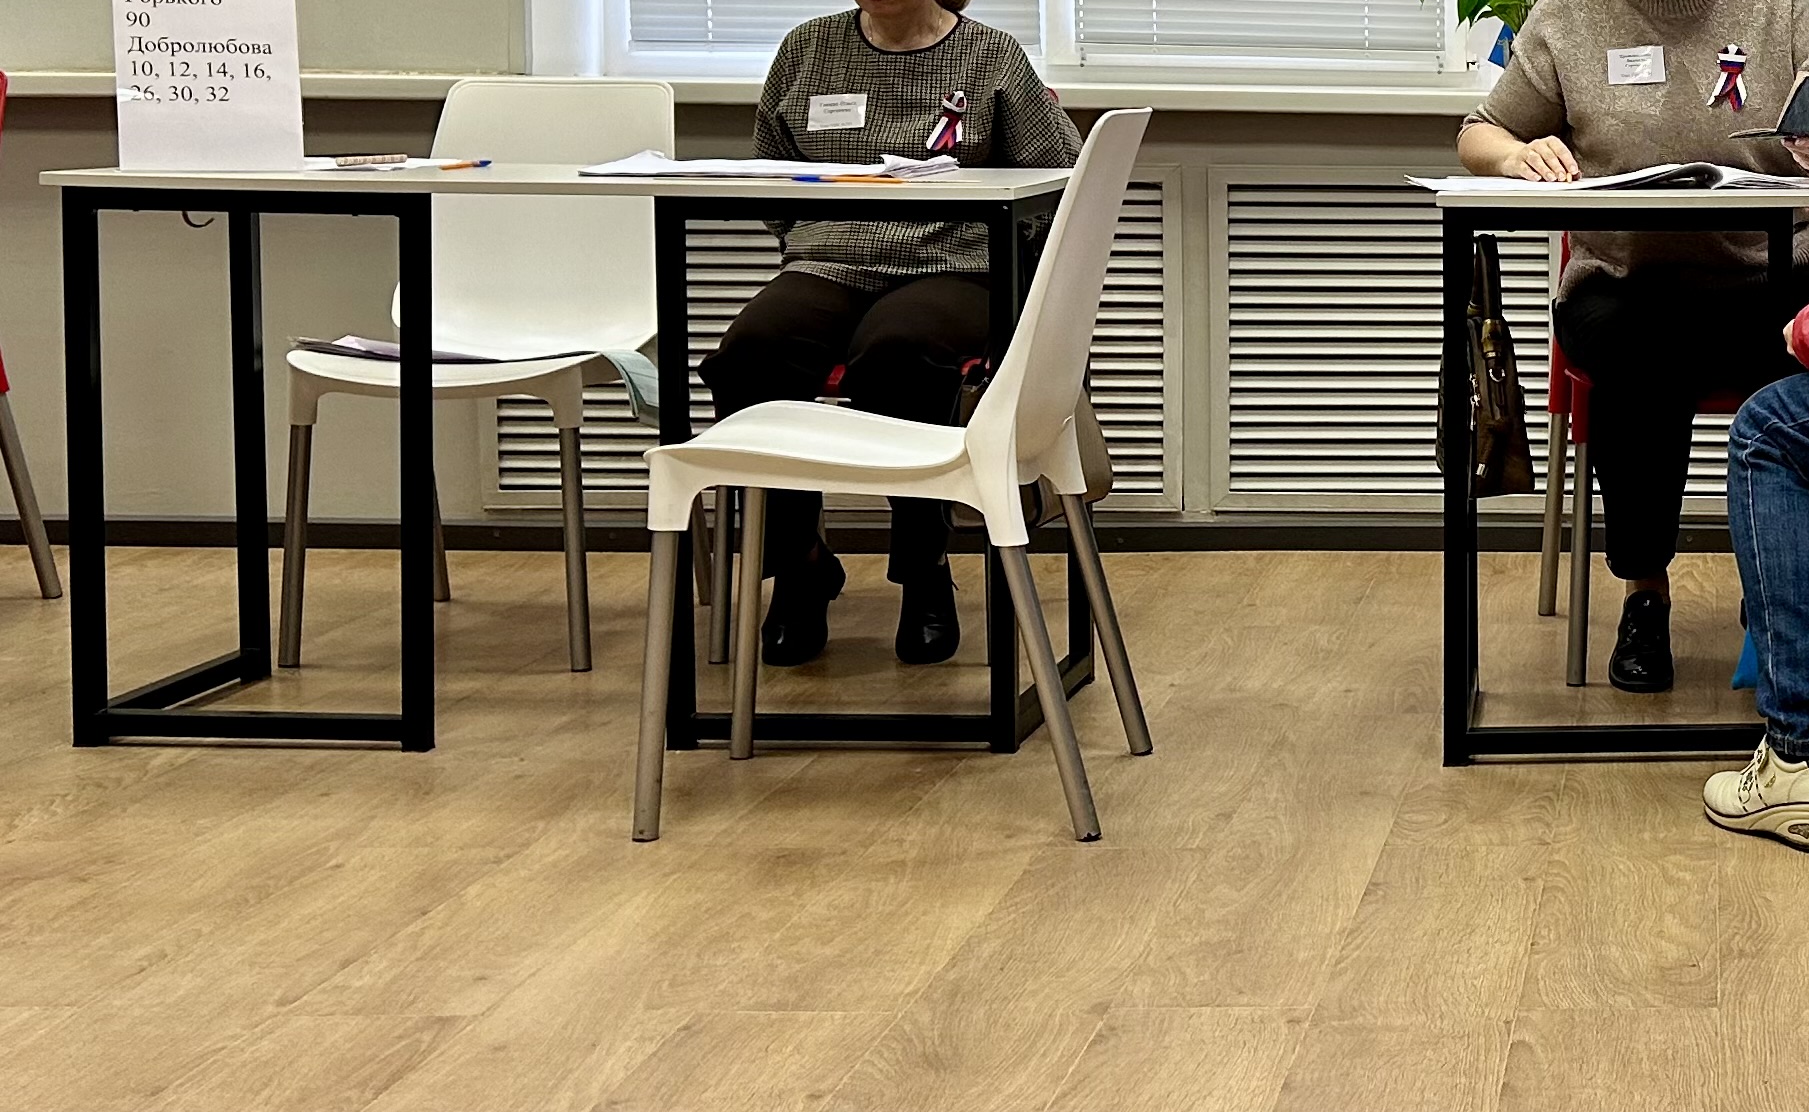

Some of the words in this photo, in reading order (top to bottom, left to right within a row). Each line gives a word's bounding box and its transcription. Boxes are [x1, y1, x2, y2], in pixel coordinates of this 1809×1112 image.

[126, 11, 151, 28] 90
[127, 36, 272, 57] Добролюбова
[132, 60, 160, 80] 10,
[169, 61, 198, 80] 12,
[206, 62, 235, 80] 14,
[244, 63, 271, 81] 16,
[168, 85, 199, 104] 30,
[206, 86, 230, 102] 32
